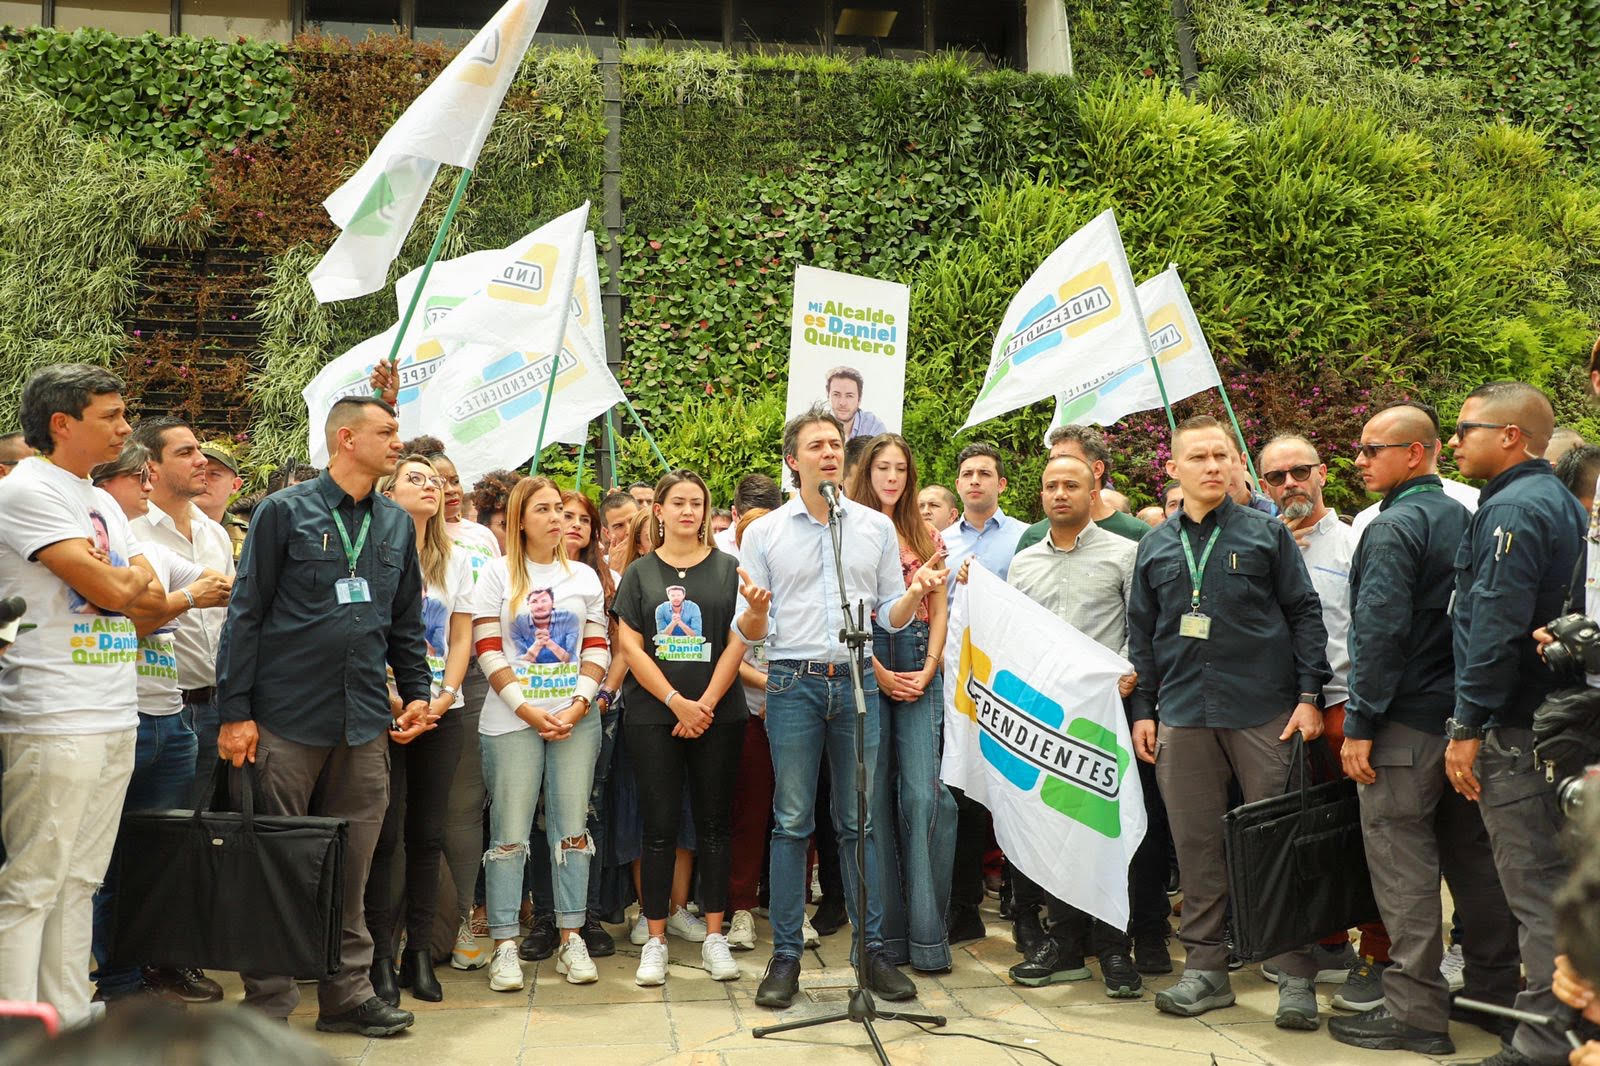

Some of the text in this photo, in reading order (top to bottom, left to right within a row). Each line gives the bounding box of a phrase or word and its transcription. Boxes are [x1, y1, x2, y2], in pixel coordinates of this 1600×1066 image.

[808, 300, 896, 326] Mi Alcalde
[803, 314, 897, 343] es Daniel
[804, 327, 896, 356] Quintero
[73, 623, 90, 633] Mi
[70, 636, 97, 648] es
[669, 644, 703, 652] Daniel
[658, 652, 703, 660] Quintero
[527, 664, 578, 676] Alcalde
